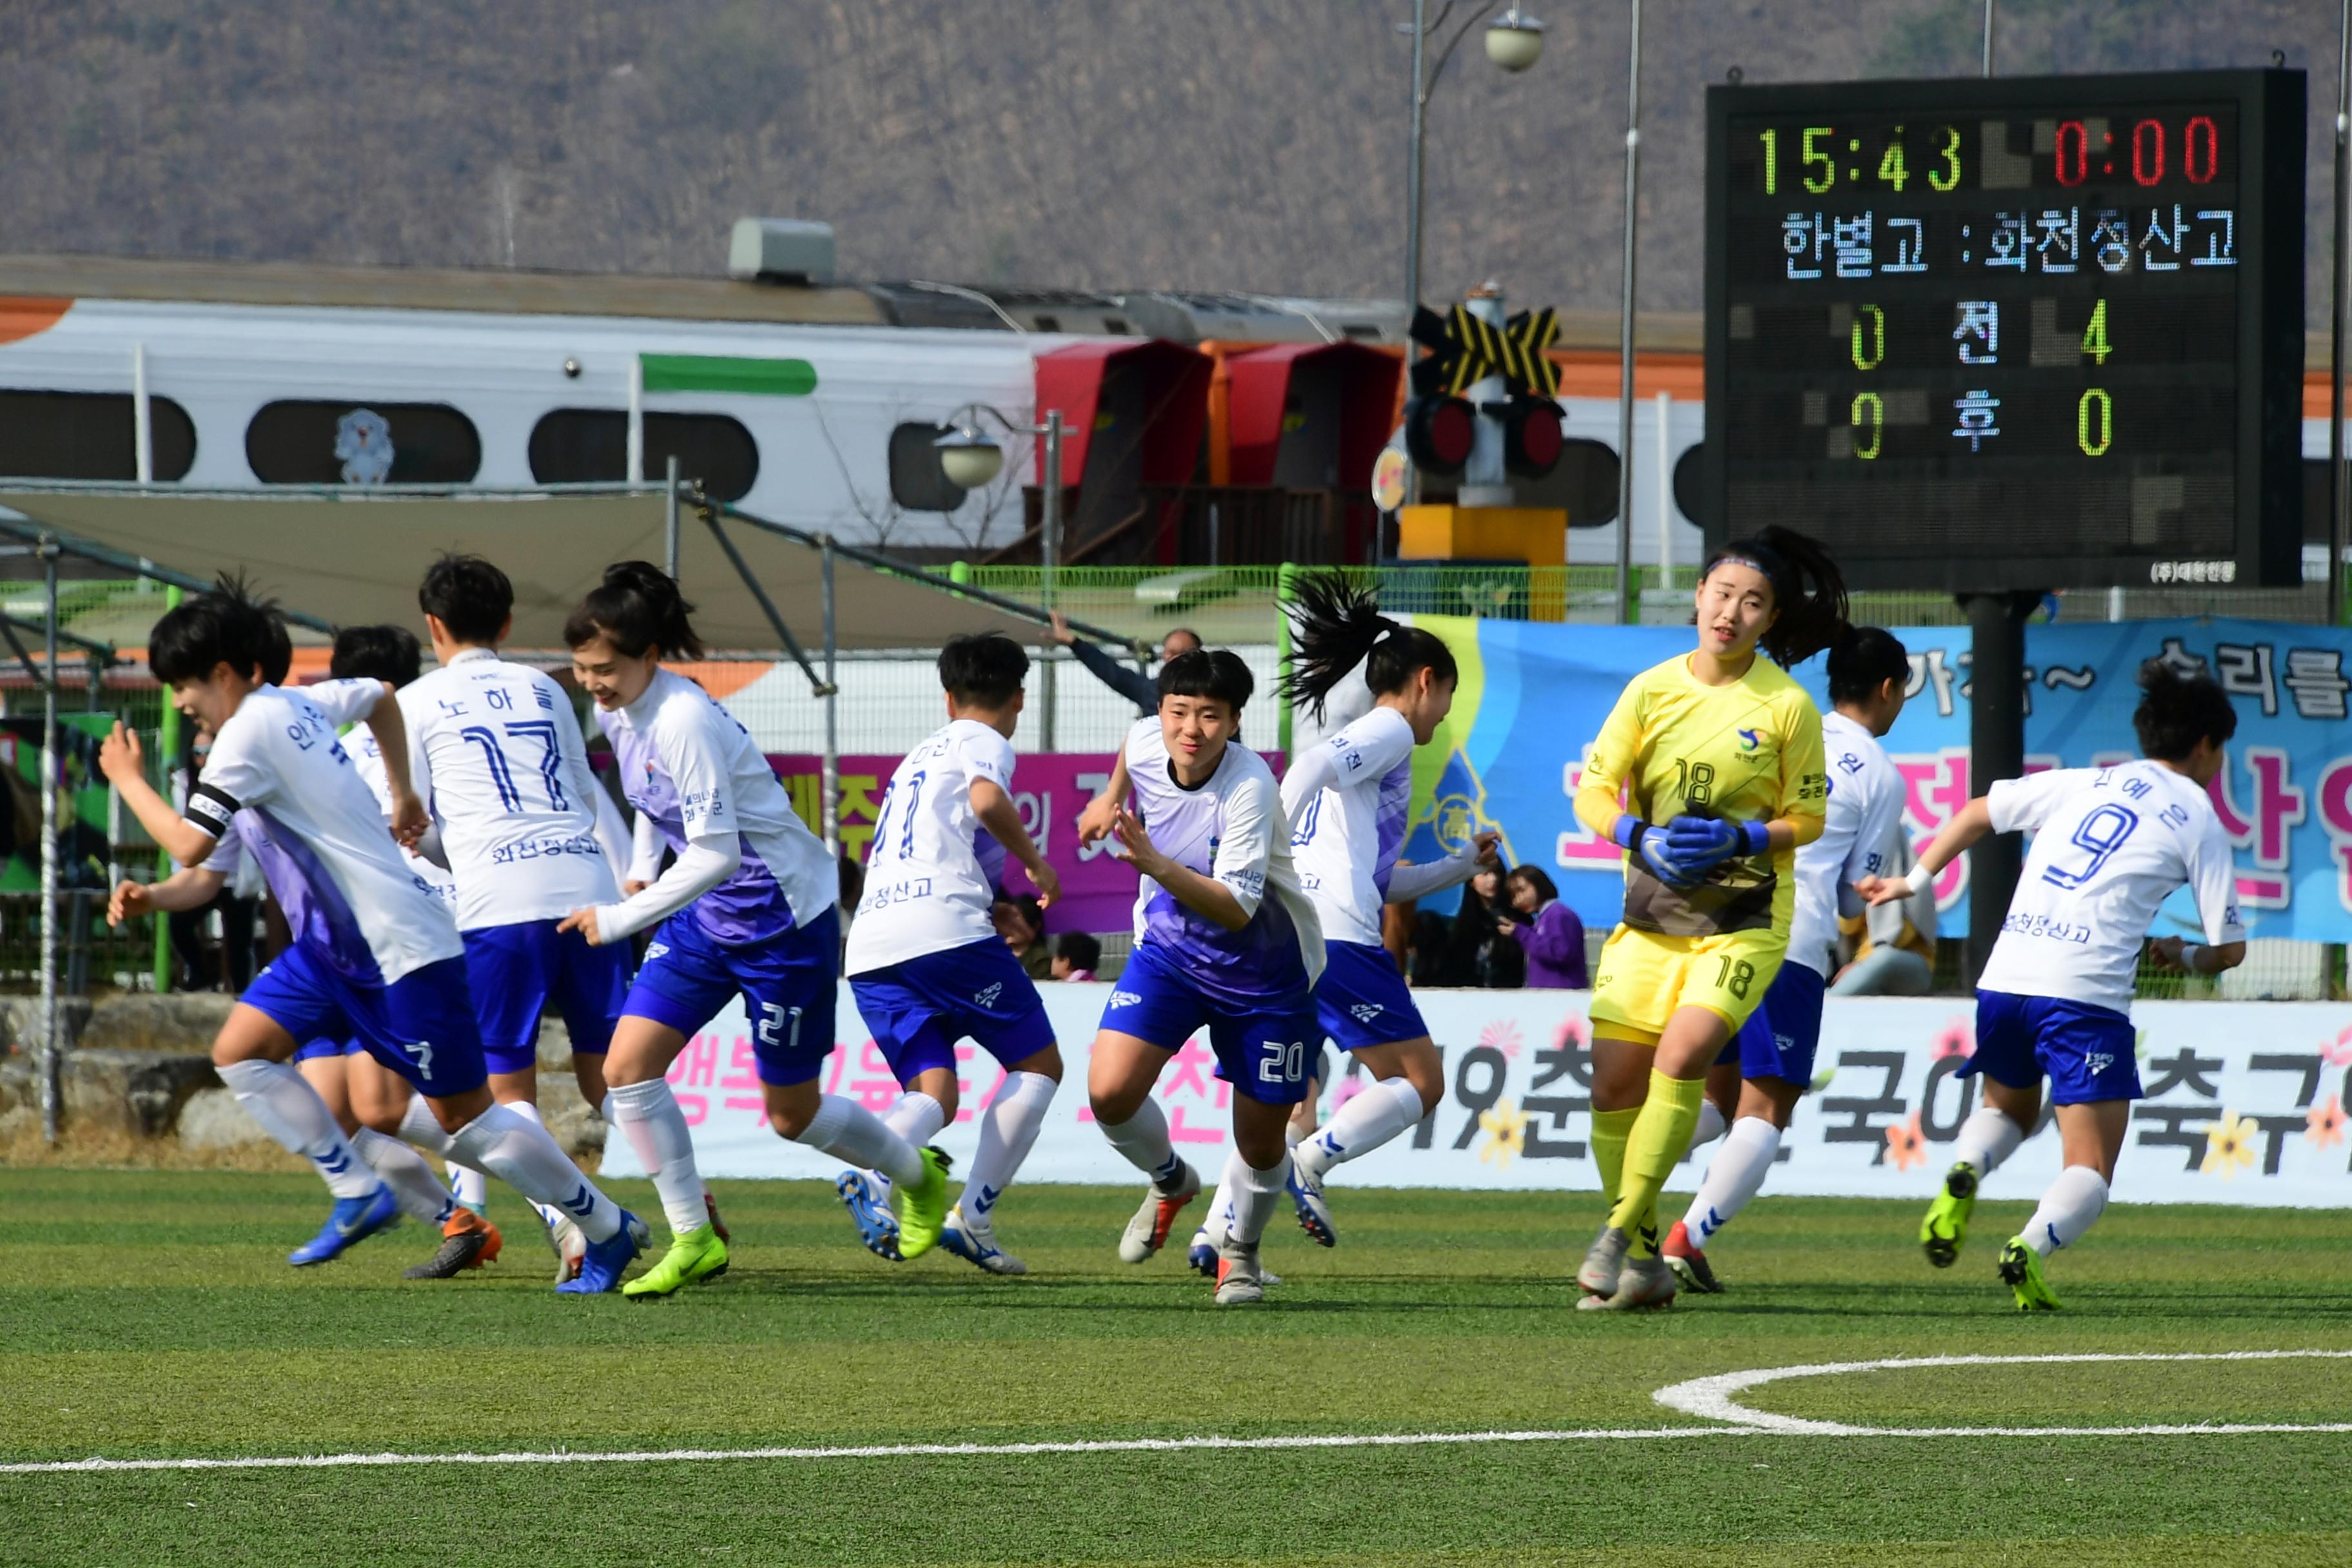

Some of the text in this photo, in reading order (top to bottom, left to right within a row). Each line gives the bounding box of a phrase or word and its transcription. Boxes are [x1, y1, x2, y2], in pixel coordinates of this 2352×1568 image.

[1760, 116, 2217, 193] 15:43 0:00
[1781, 210, 1928, 279] 한별고
[1952, 301, 1998, 364] 전
[2081, 299, 2113, 365] 4
[1952, 390, 2001, 451] 후
[2078, 388, 2112, 456] 0
[460, 719, 569, 813] 17
[1676, 757, 1715, 805] 18
[2042, 803, 2139, 891] 9
[974, 981, 1002, 1003] KSPO
[1716, 955, 1755, 1001] 18
[758, 1001, 803, 1046] 21
[405, 1041, 433, 1081] 7
[1259, 1041, 1304, 1083] 20
